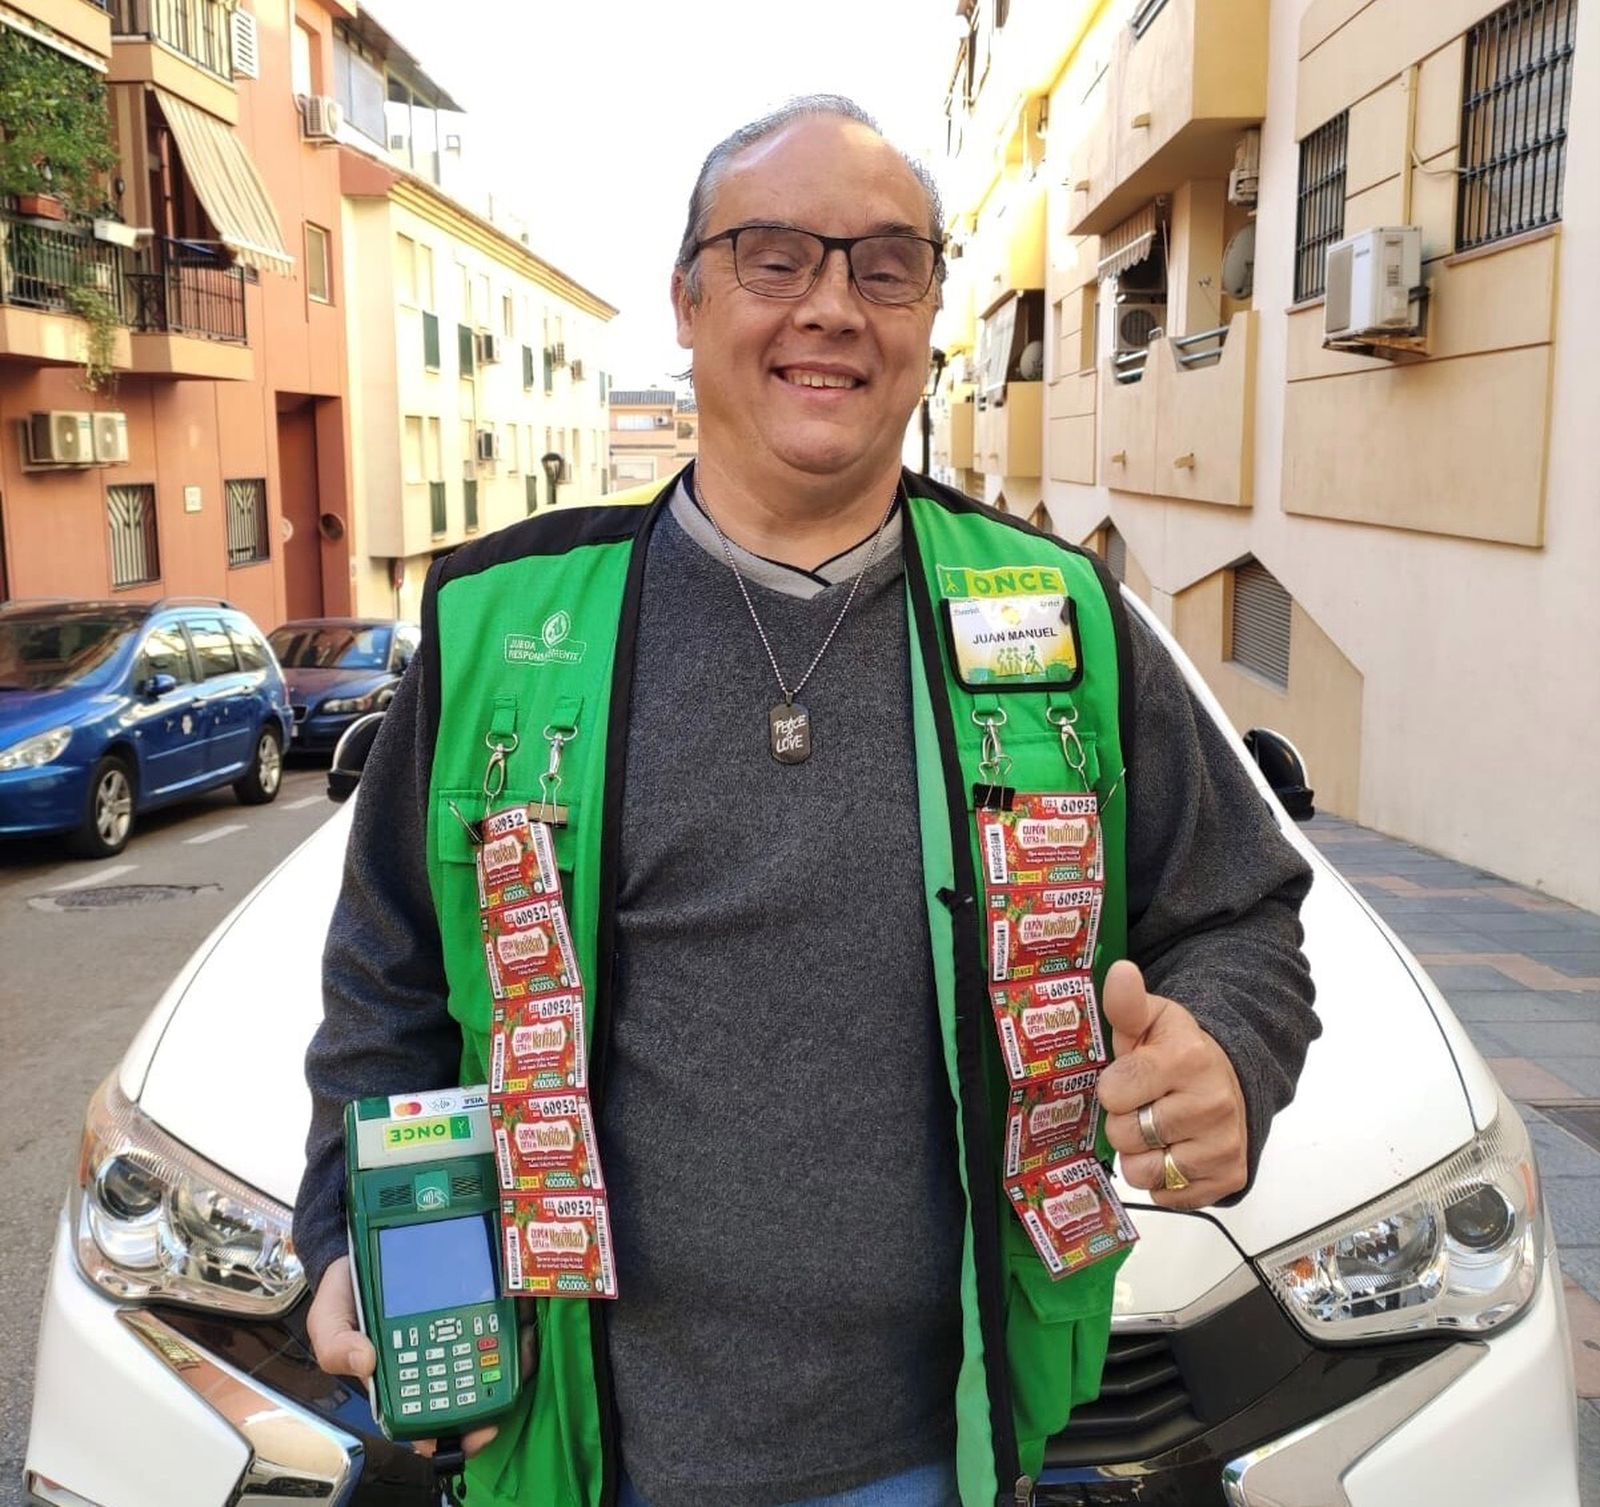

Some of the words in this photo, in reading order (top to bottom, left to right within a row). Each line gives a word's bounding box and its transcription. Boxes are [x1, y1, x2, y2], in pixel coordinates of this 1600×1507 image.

[974, 571, 1059, 595] ONCE
[972, 631, 1006, 645] JUAN
[1007, 626, 1059, 641] MANUEL
[773, 714, 807, 735] PEACE
[776, 734, 804, 753] LOVE
[1060, 799, 1096, 813] 60952
[1022, 823, 1046, 835] CUPÓN
[1057, 890, 1091, 905] 60952
[515, 905, 548, 925] 60952
[1050, 979, 1082, 997] 60952
[541, 998, 571, 1017] 60952
[1064, 1072, 1095, 1092] 60952
[542, 1098, 577, 1115] 60952
[390, 1123, 446, 1143] ONCE
[1062, 1162, 1092, 1184] 60952
[557, 1200, 592, 1216] 60952
